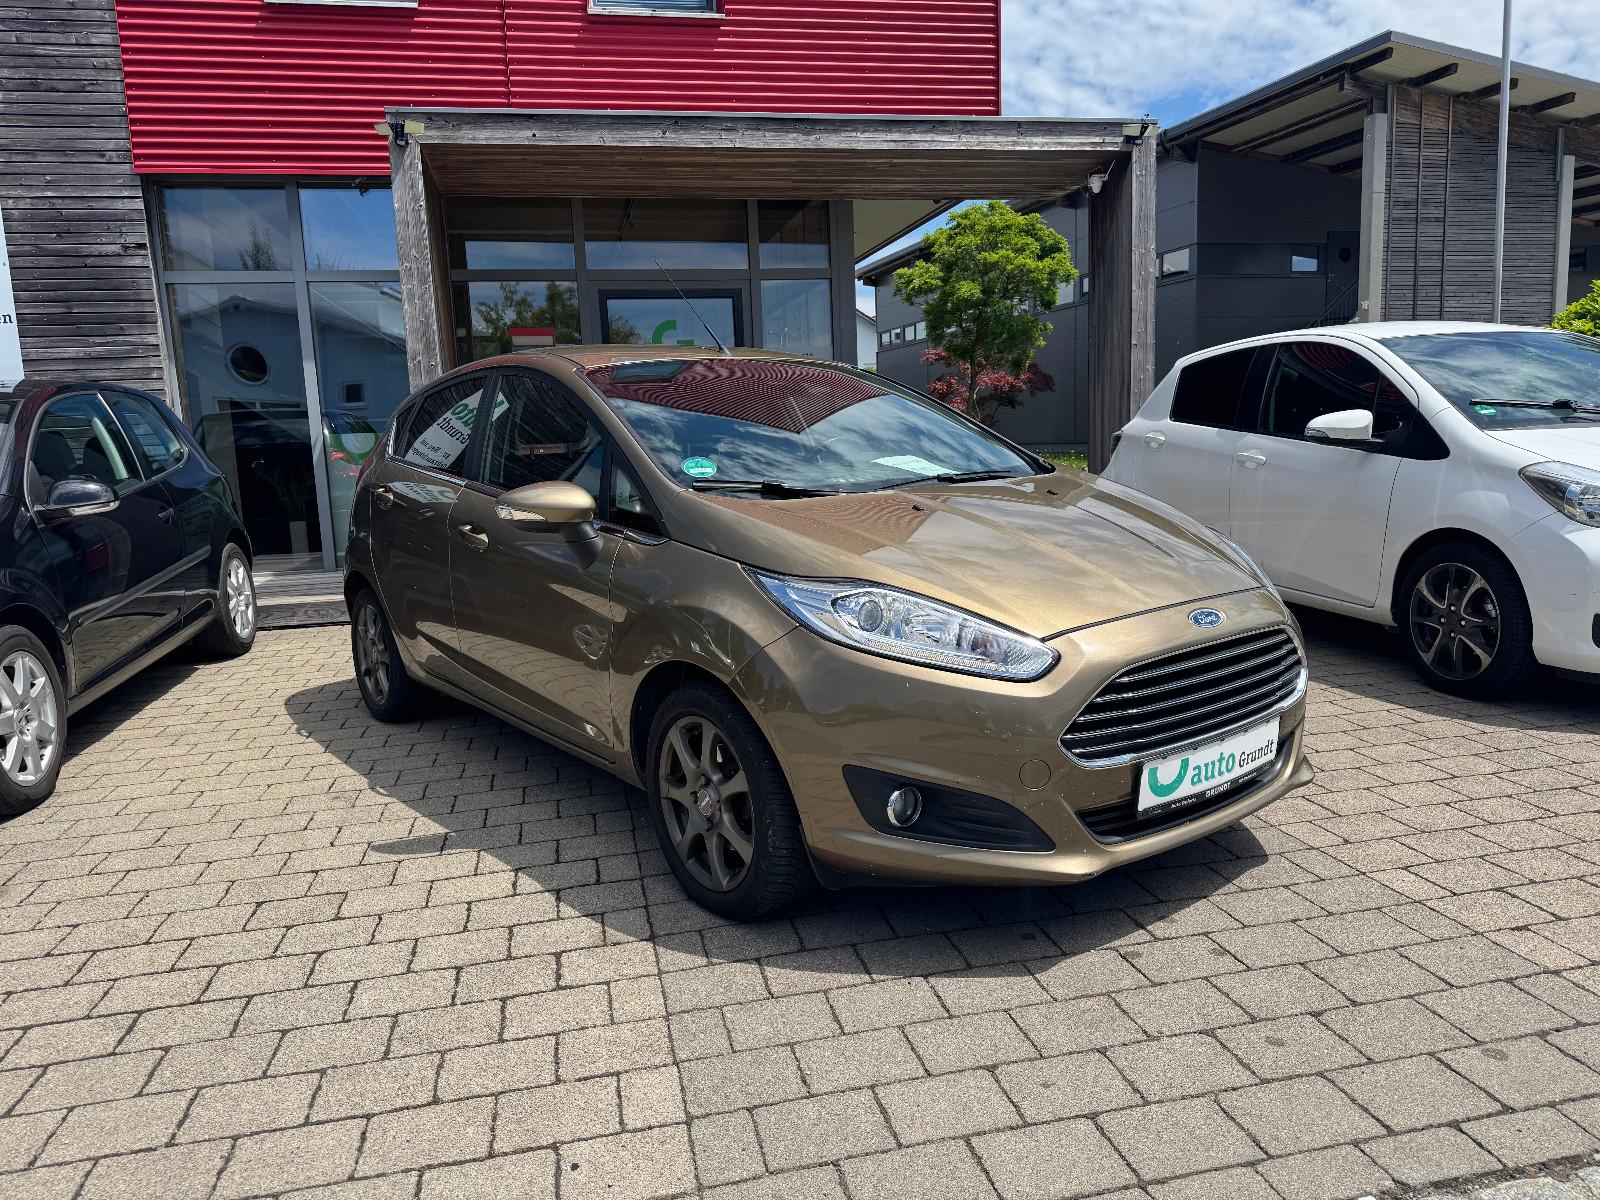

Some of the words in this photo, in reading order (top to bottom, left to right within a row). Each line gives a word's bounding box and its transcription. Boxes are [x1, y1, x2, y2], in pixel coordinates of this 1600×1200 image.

[1198, 612, 1218, 624] Ford
[1190, 751, 1236, 787] auto
[1238, 739, 1274, 768] Grundt
[1205, 782, 1231, 798] GRUNDT
